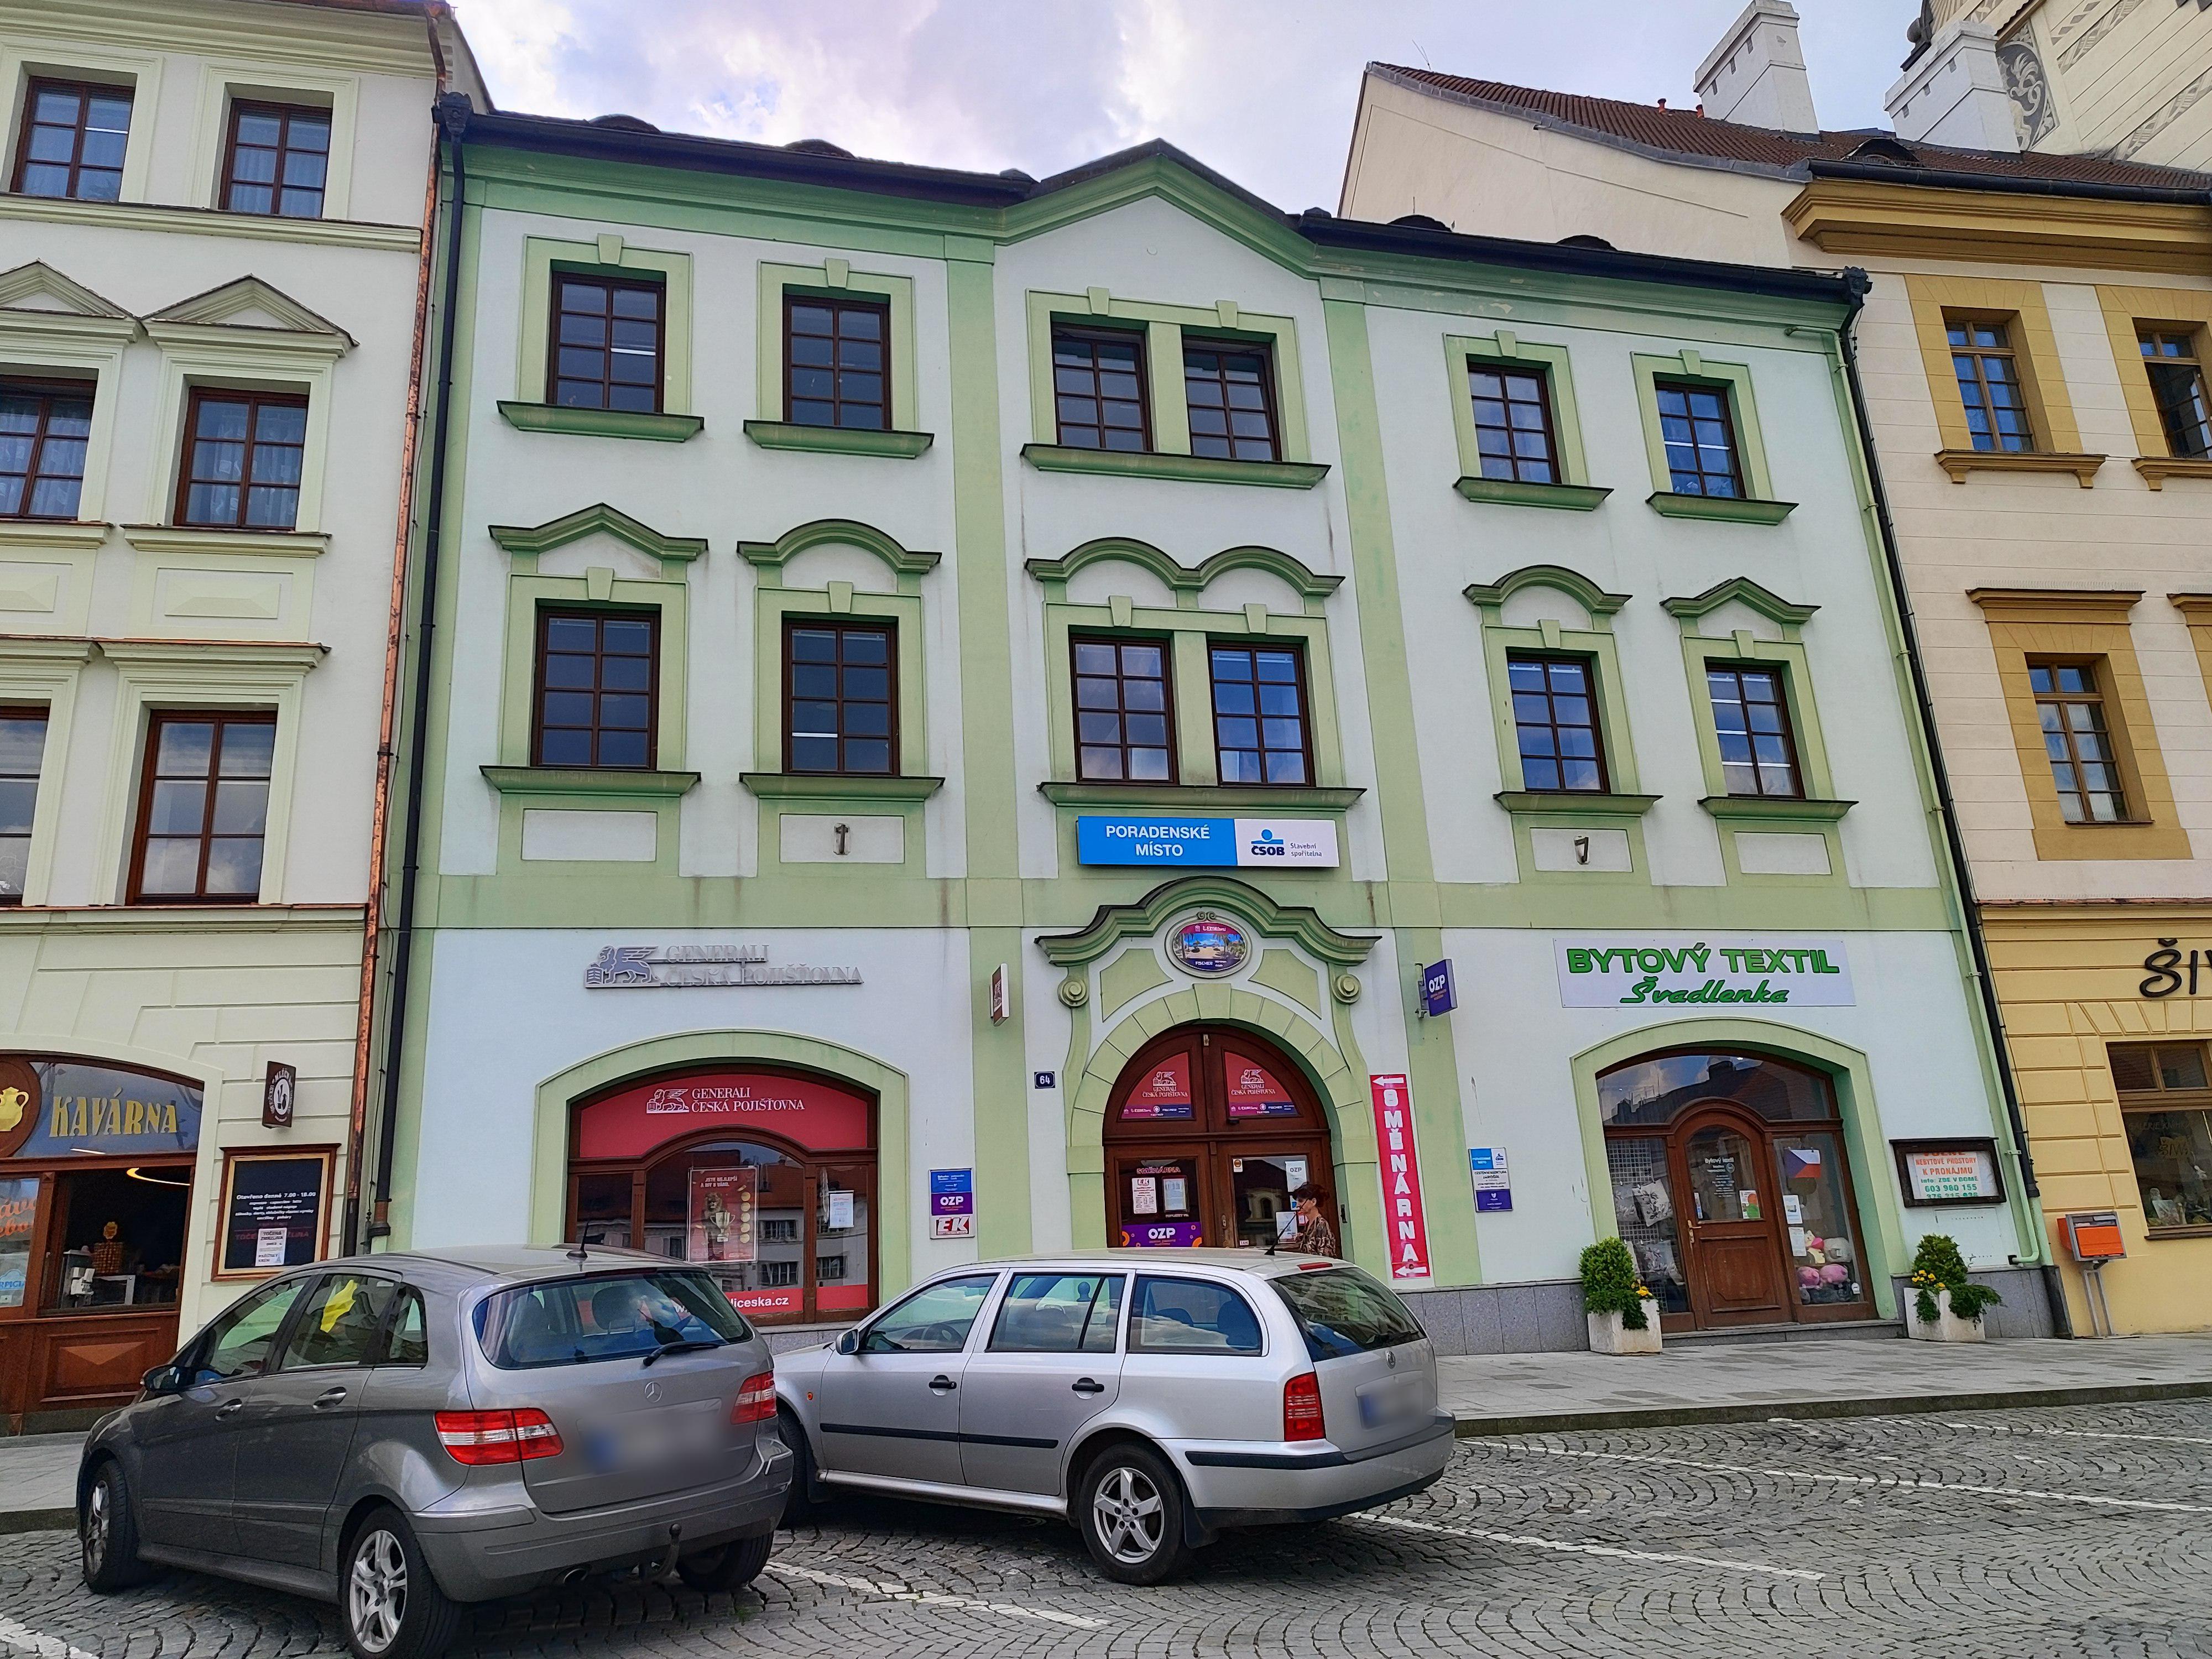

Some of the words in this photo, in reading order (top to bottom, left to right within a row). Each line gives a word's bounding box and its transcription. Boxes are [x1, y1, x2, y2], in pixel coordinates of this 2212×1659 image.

[1106, 824, 1210, 839] PORADENSKÉ
[1135, 842, 1183, 857] MÍSTO
[1251, 845, 1285, 856] ČSOB
[665, 944, 769, 963] GENERALI
[1566, 942, 1712, 973] BYTOVÝ
[1720, 948, 1840, 973] TEXTIL
[665, 966, 734, 987] ČESKÁ
[740, 963, 864, 985] POJIŠŤOVNA
[1428, 974, 1445, 993] OZP
[1620, 976, 1790, 1004] Švadlenka
[1040, 1075, 1051, 1084] 64
[692, 1087, 751, 1099] GENERALI
[49, 1087, 177, 1138] KAVÁRNA
[691, 1099, 730, 1113] ČESKÁ
[733, 1098, 805, 1112] POJIŠŤOVNA
[1383, 1089, 1419, 1262] SMĚNÁRNA
[940, 1196, 964, 1206] OZP
[937, 1216, 970, 1232] EK
[1148, 1227, 1176, 1239] OZP
